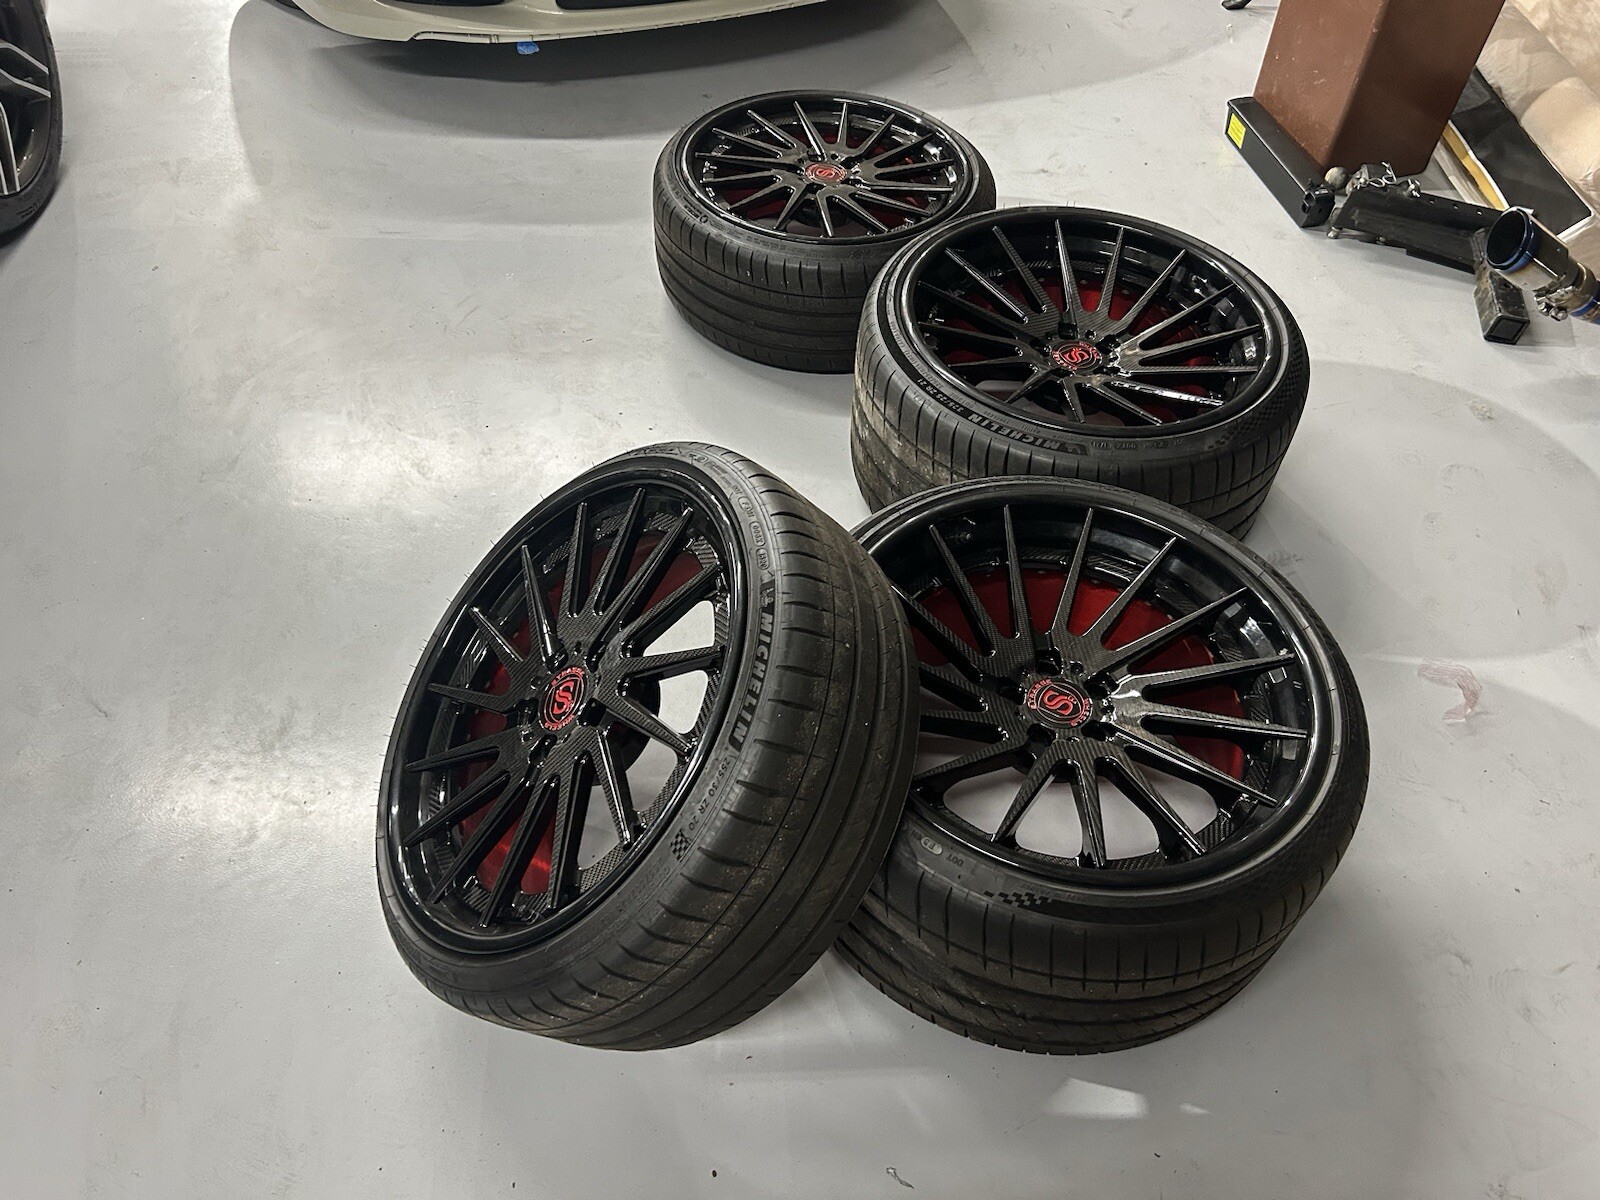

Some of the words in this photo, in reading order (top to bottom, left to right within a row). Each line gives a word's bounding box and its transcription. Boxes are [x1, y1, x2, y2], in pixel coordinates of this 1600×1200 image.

[968, 413, 1061, 450] MICHELIN
[732, 612, 774, 744] MICHELIN
[708, 757, 731, 797] 255/30
[688, 815, 699, 831] 20
[698, 798, 710, 815] ZR
